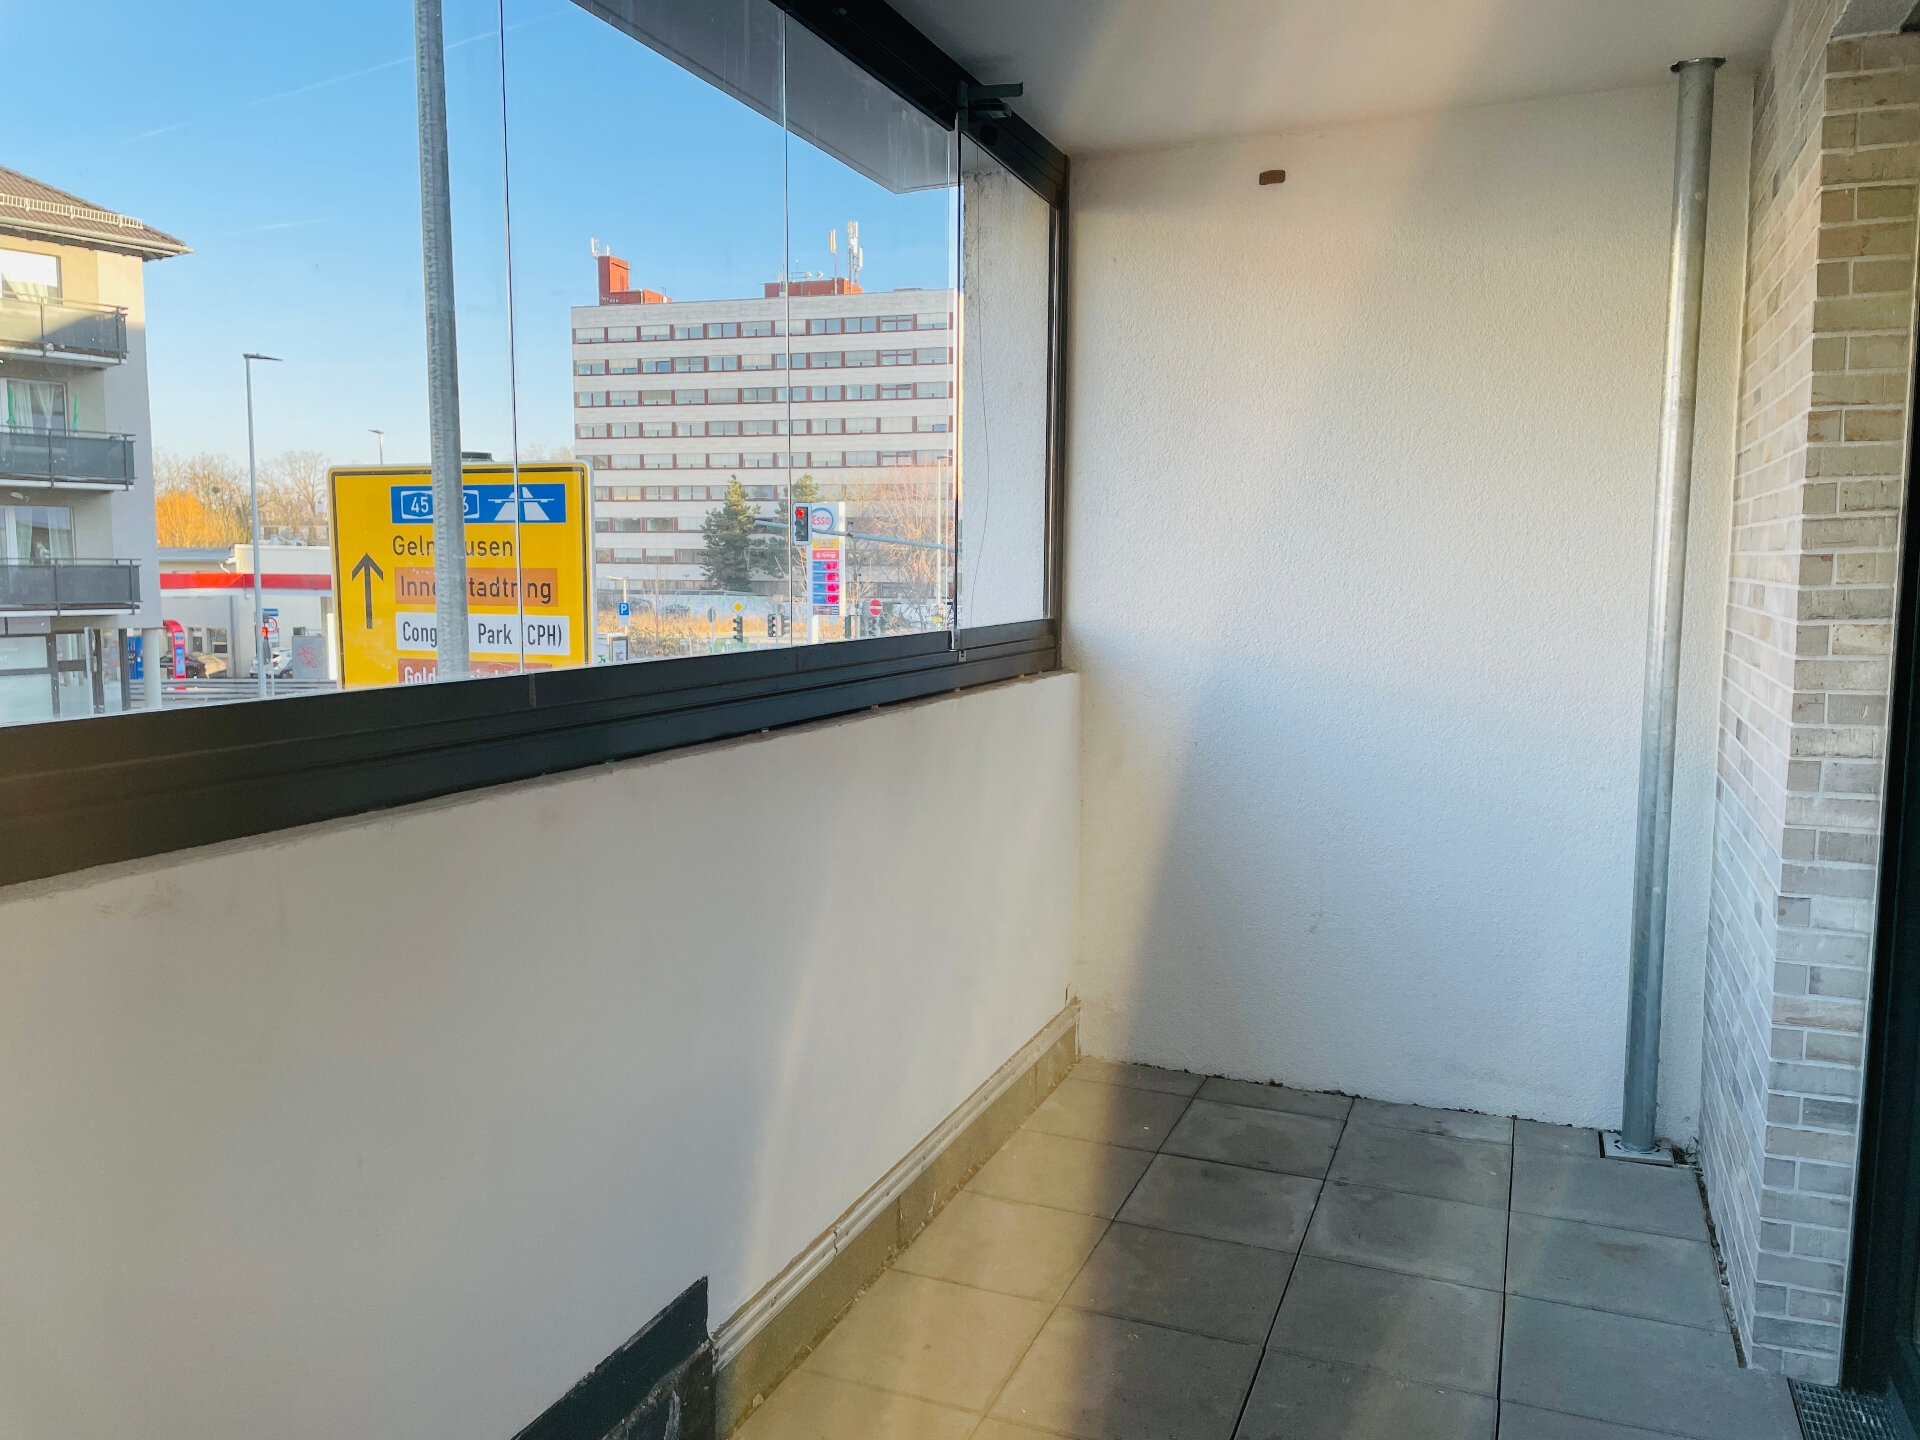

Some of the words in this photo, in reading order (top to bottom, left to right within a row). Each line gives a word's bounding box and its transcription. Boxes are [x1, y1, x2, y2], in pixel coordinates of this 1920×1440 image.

[410, 496, 429, 514] 45
[392, 535, 513, 557] Gelnusen
[400, 575, 552, 605] Inntadtrng
[620, 603, 628, 614] P
[477, 622, 513, 645] Park
[525, 624, 562, 648] CPH)
